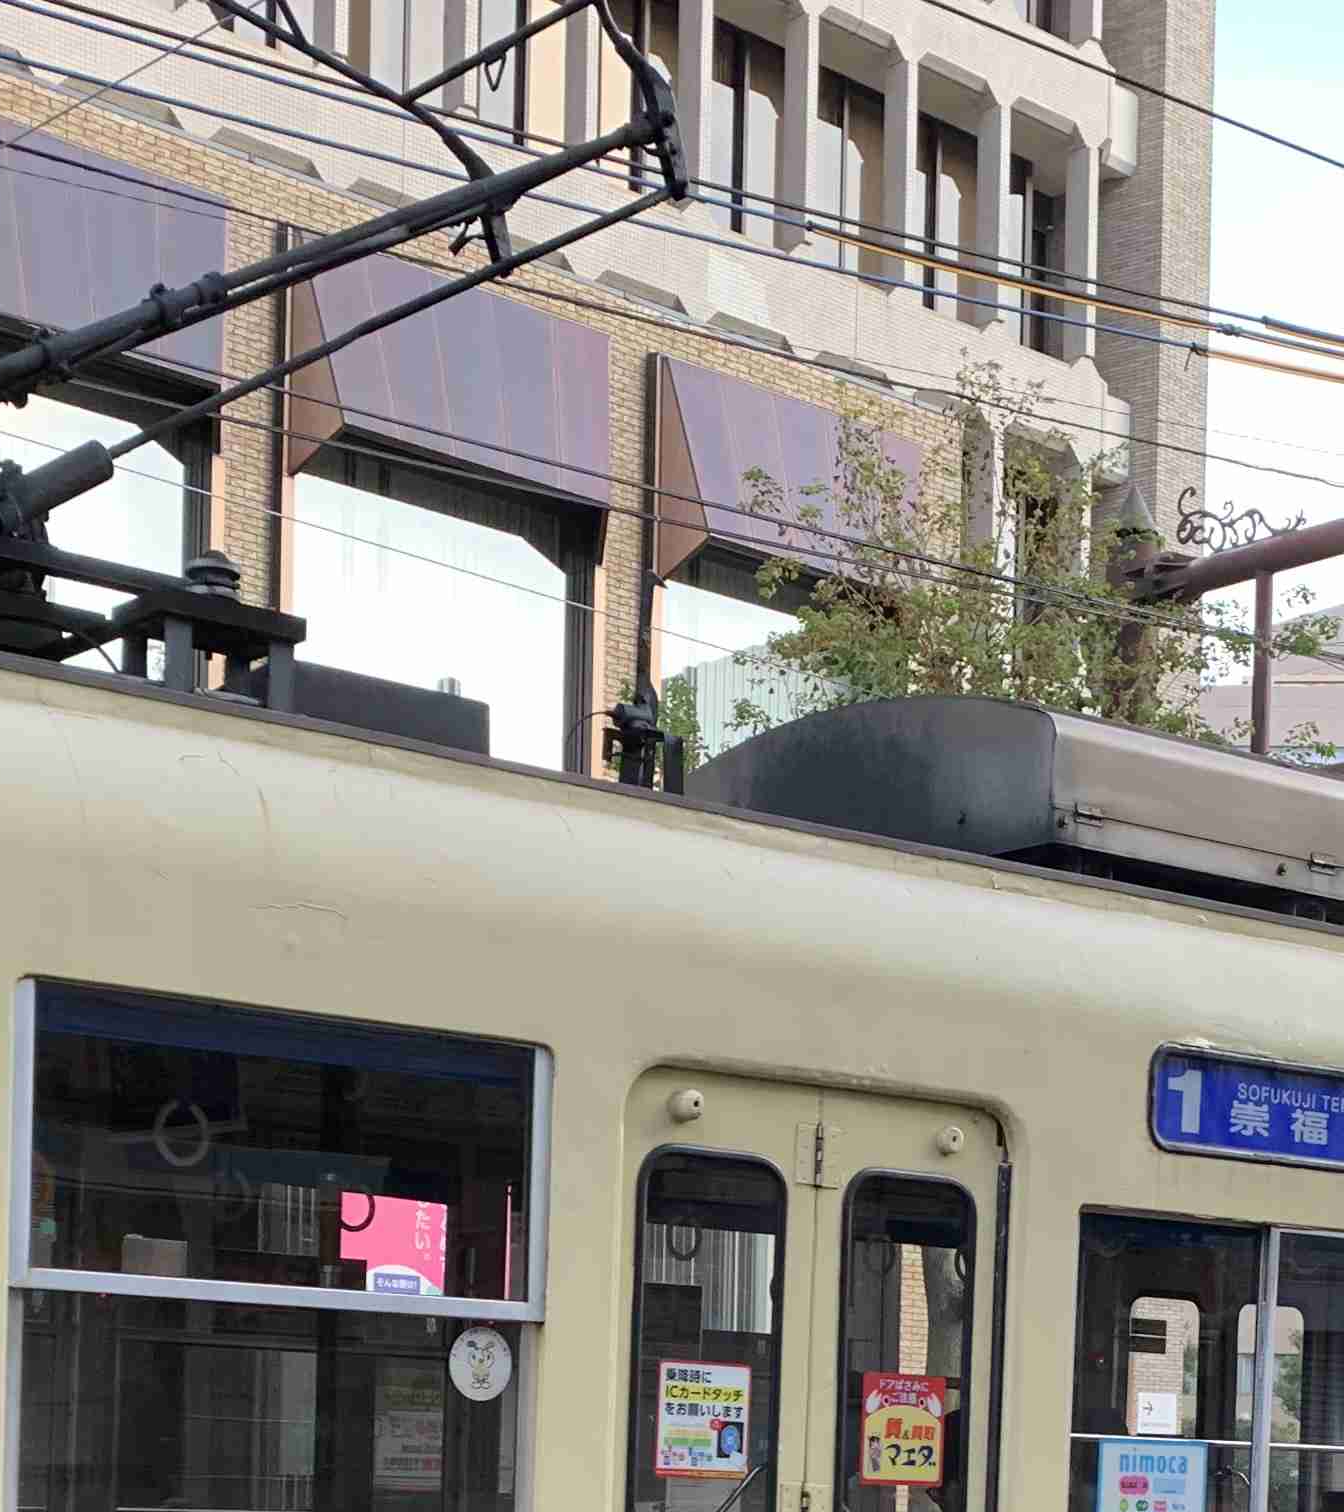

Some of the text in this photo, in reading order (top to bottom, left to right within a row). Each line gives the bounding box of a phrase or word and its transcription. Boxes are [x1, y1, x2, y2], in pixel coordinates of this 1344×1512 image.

[1167, 1069, 1203, 1135] 1
[1237, 1082, 1317, 1109] SOFUKUJI
[665, 1385, 744, 1402] ICカードタッチ
[665, 1402, 743, 1418] をお願いします
[1119, 1453, 1188, 1474] nimoca
